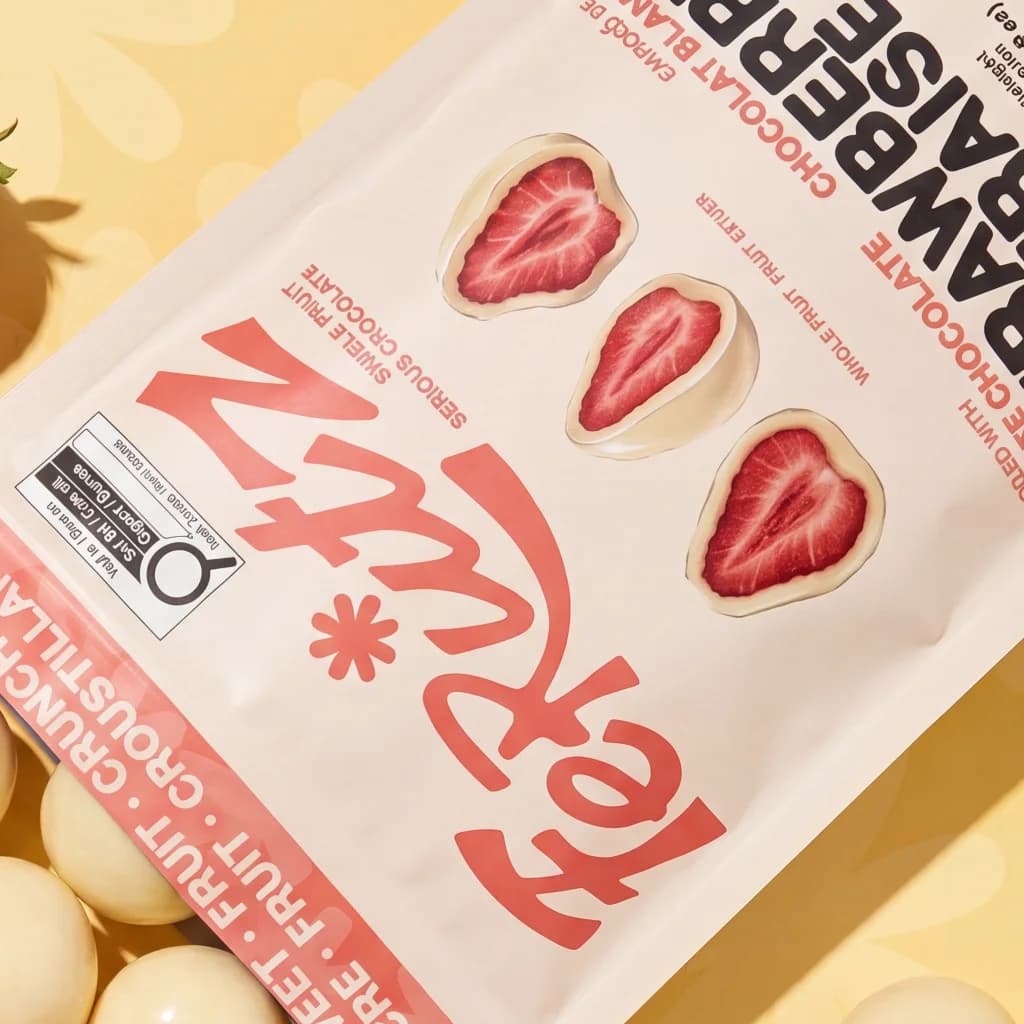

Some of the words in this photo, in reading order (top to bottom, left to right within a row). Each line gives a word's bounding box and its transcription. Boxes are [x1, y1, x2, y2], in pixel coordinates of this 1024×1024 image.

[690, 57, 838, 200] CHOCOLAT
[813, 0, 1024, 260] RAISE
[670, 0, 1024, 389] RAWBERR
[300, 264, 398, 357] CROCOLATE
[819, 326, 870, 385] WHOLE
[859, 230, 1013, 412] CHOCOLATE
[395, 353, 468, 430] SERIOUS
[958, 399, 1000, 449] WITH
[134, 815, 247, 930] FRUIT
[212, 831, 325, 948] FRUIT
